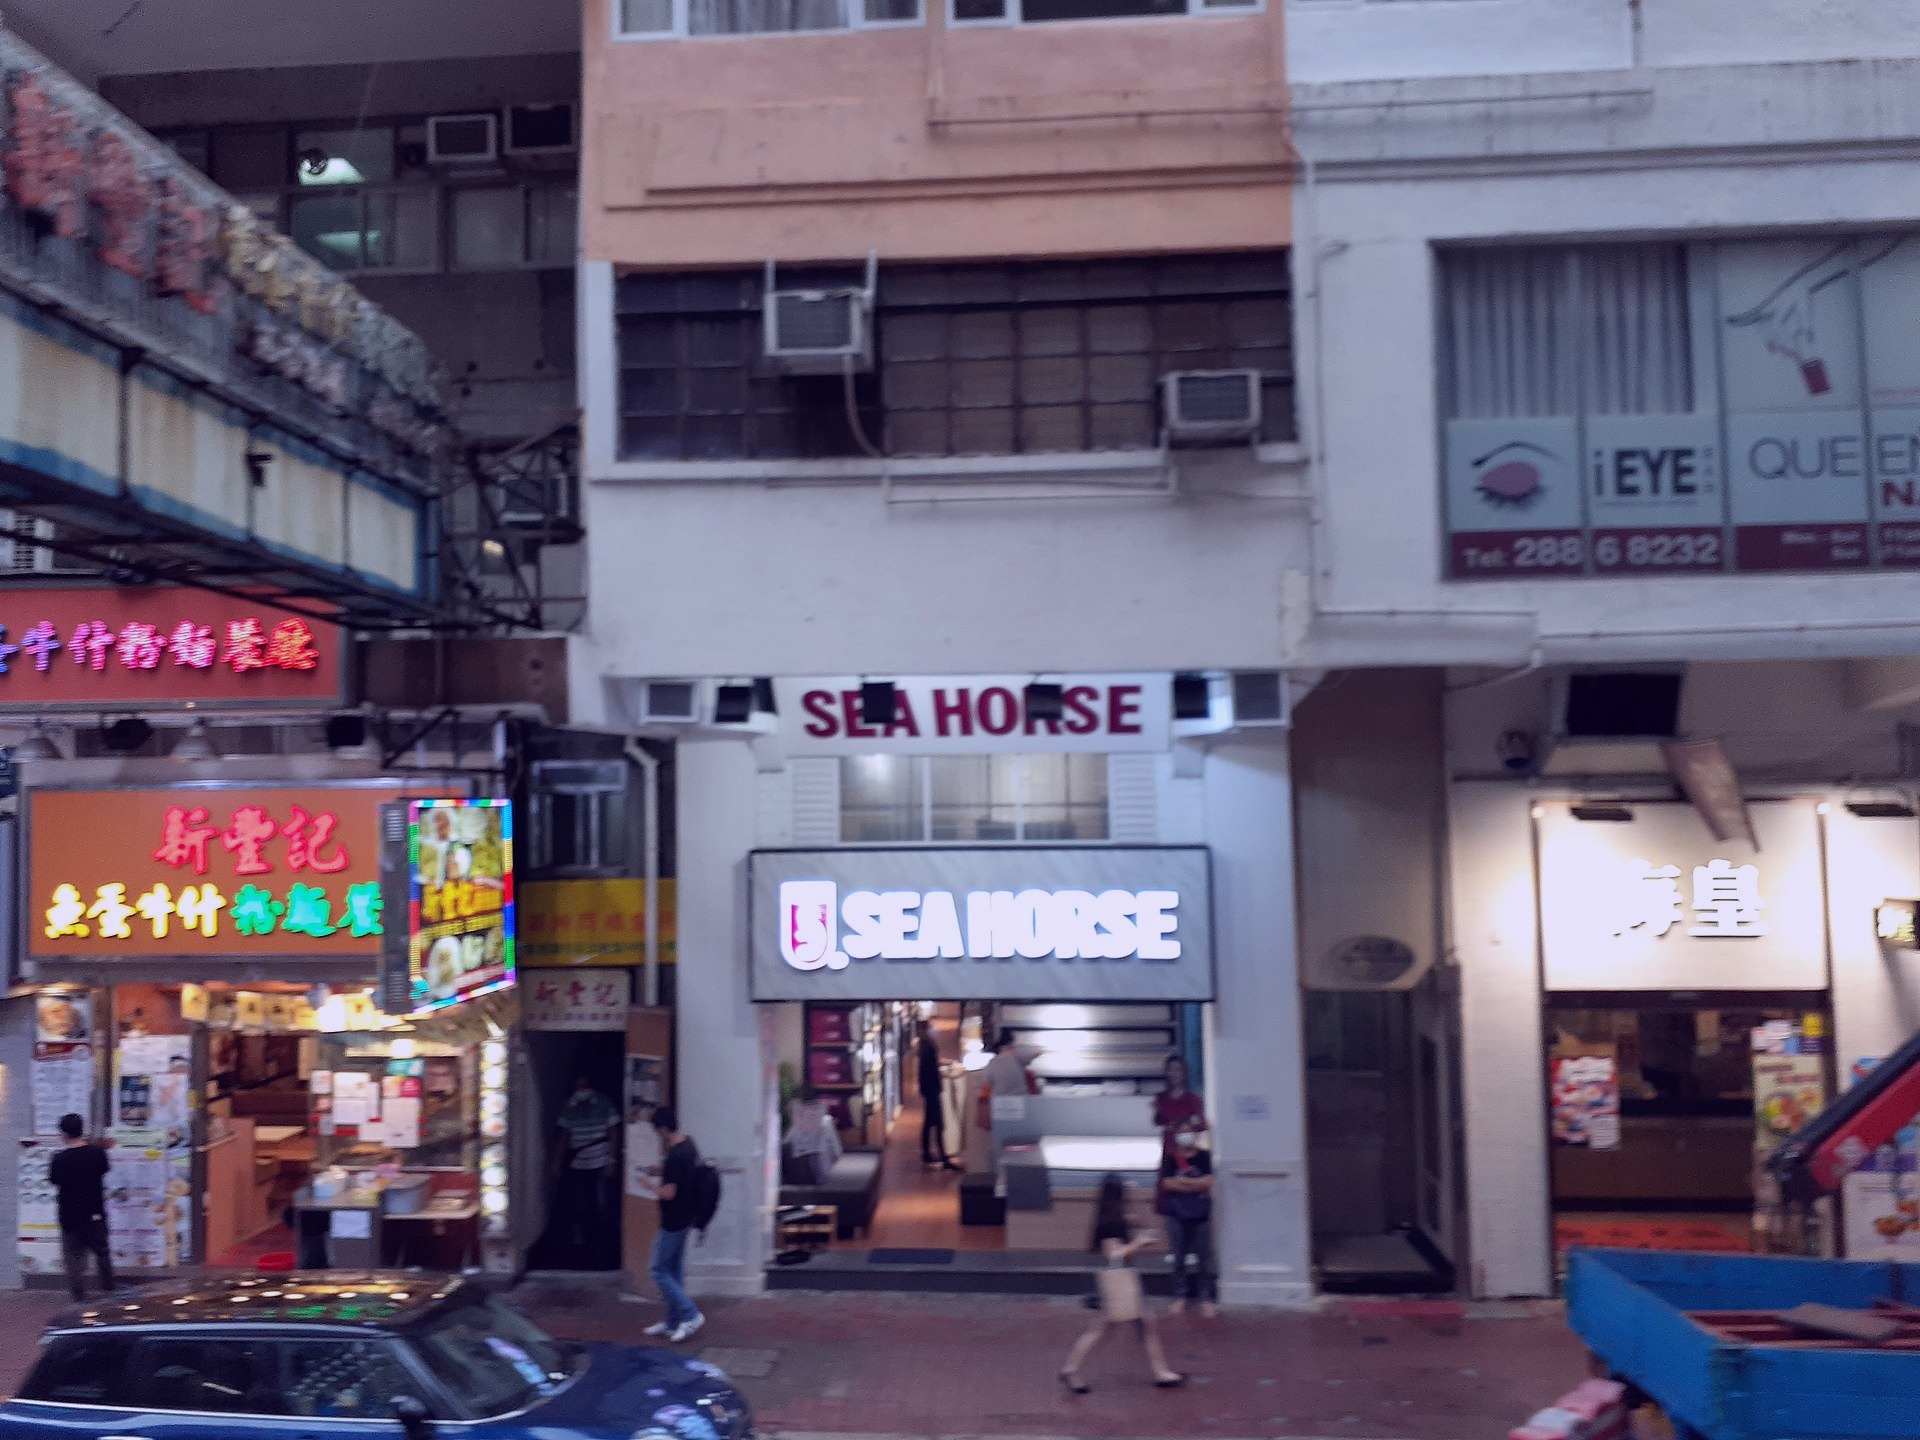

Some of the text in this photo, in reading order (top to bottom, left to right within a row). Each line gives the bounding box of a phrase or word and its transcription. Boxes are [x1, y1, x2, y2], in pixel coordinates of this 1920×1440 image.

[1627, 534, 1720, 565] 8232
[841, 888, 1182, 960] SEA HORSE
